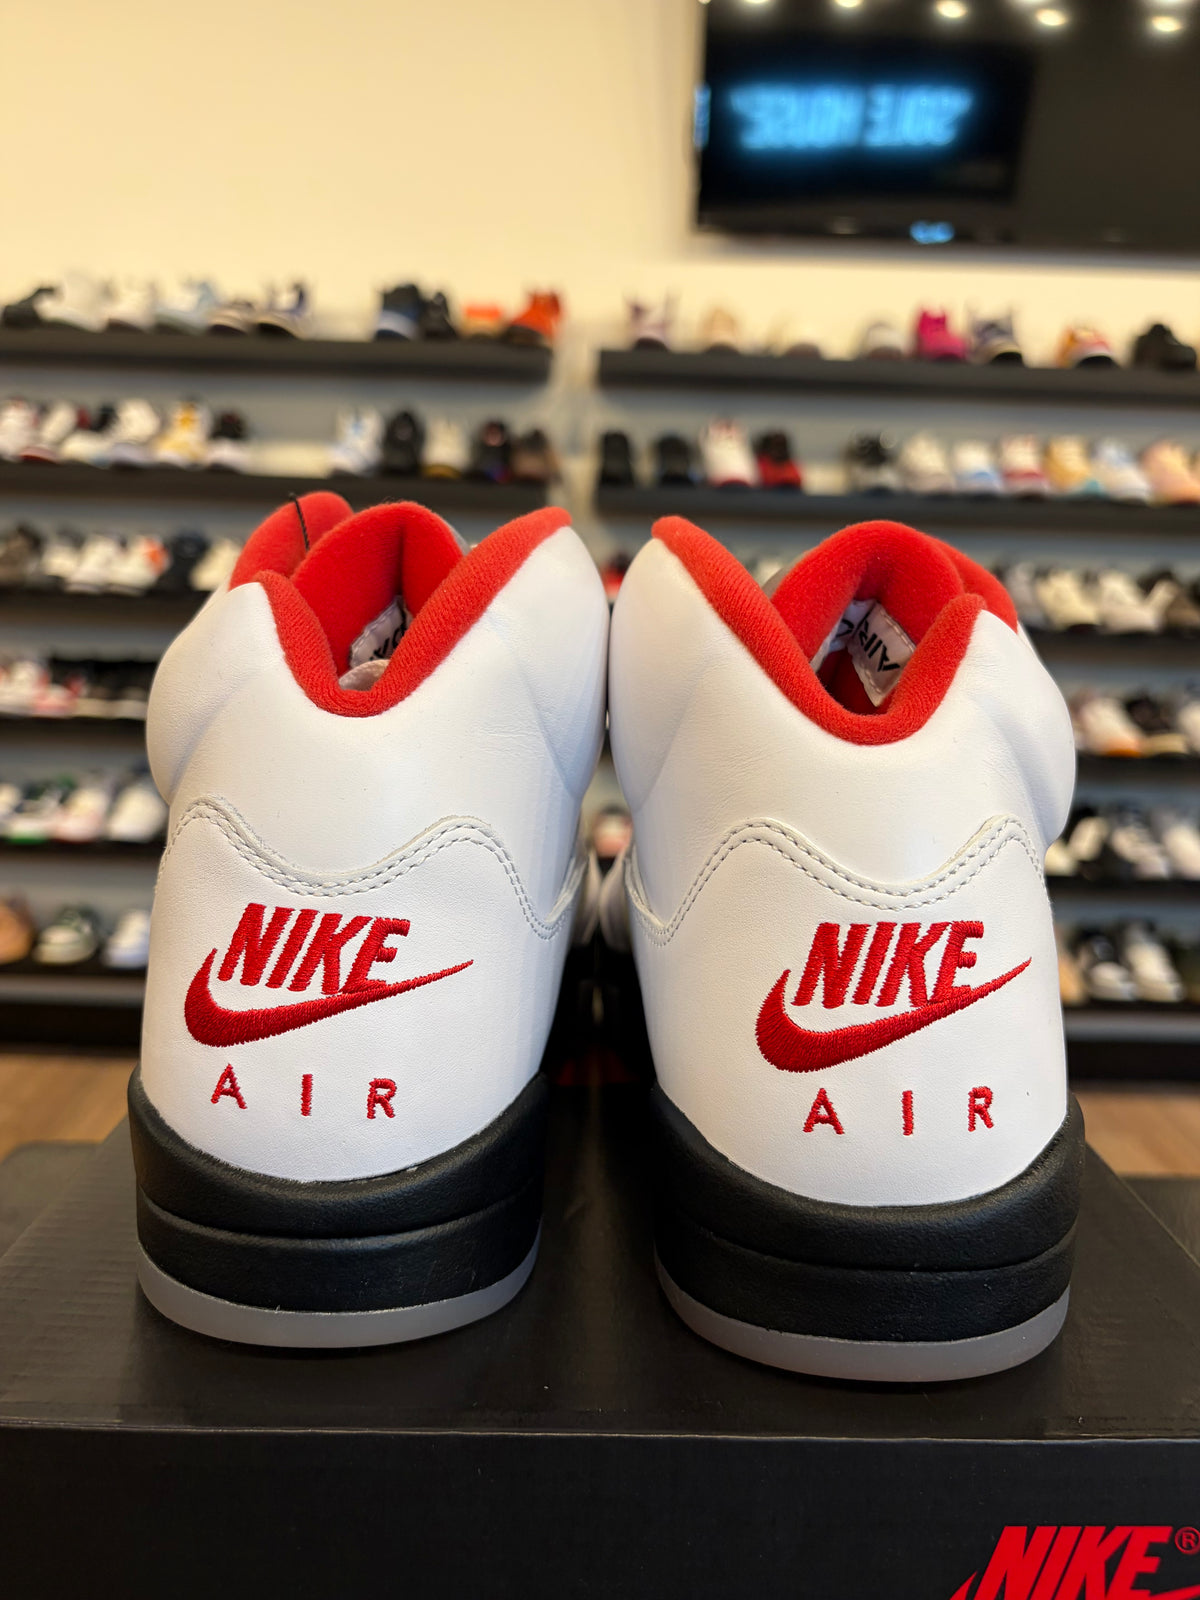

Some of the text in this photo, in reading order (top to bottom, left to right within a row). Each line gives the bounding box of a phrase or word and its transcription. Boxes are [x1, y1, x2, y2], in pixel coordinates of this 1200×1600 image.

[217, 903, 411, 995] NIKE
[790, 921, 985, 1009] NIKE
[210, 1063, 397, 1120] AIR
[803, 1086, 994, 1136] AIR
[973, 1525, 1174, 1600] NIKE
